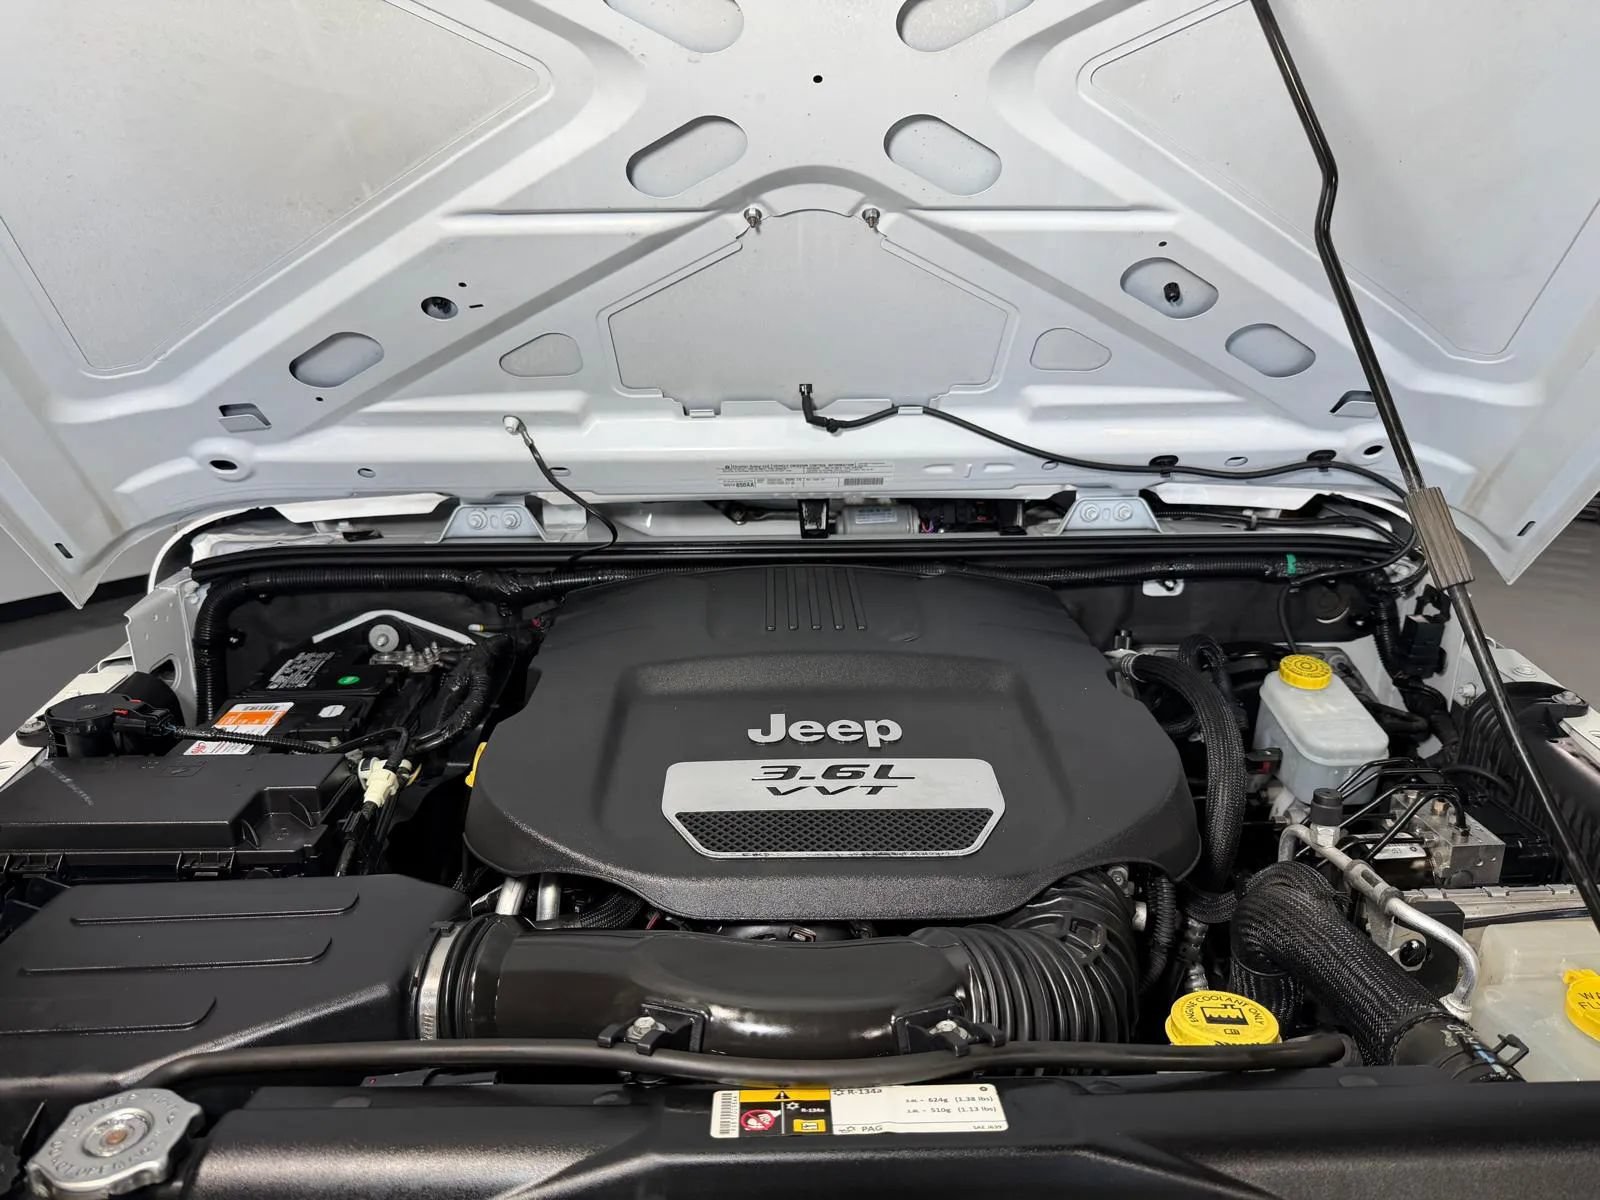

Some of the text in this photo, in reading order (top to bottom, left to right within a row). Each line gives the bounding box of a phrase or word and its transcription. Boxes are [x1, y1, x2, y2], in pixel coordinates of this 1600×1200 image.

[747, 713, 903, 748] Jeep
[751, 764, 916, 781] 3.6L
[766, 785, 898, 796] VVT
[1185, 995, 1265, 1026] ENGINE COOLANT ONLY
